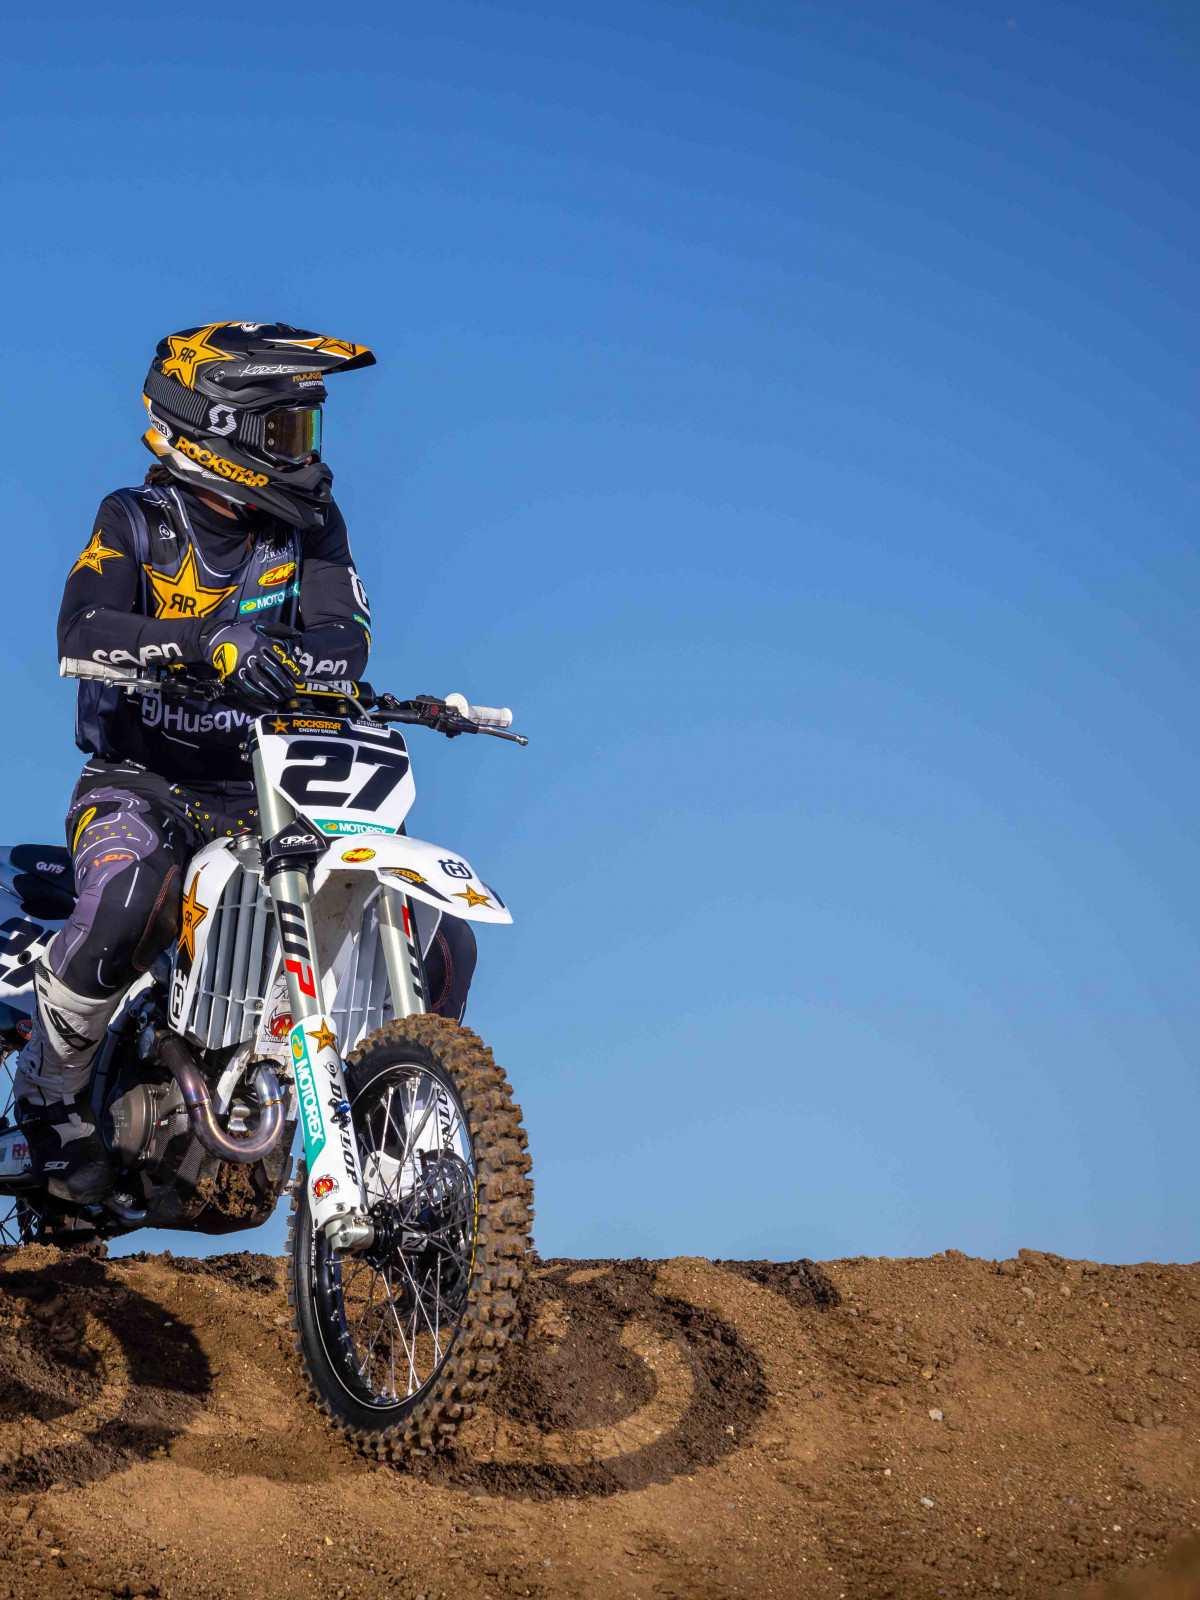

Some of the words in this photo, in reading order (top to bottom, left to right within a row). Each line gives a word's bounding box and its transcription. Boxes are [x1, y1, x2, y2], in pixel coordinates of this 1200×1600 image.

[175, 436, 269, 487] ROCKSTAR
[164, 707, 256, 732] Husqv
[293, 720, 341, 730] ROCKSTAR
[357, 720, 382, 728] STEWART
[280, 740, 408, 812] 27
[339, 823, 387, 834] MOTOREX
[36, 861, 65, 875] GUTS
[296, 1059, 324, 1145] MOTOREX
[330, 1081, 359, 1186] DNLOP
